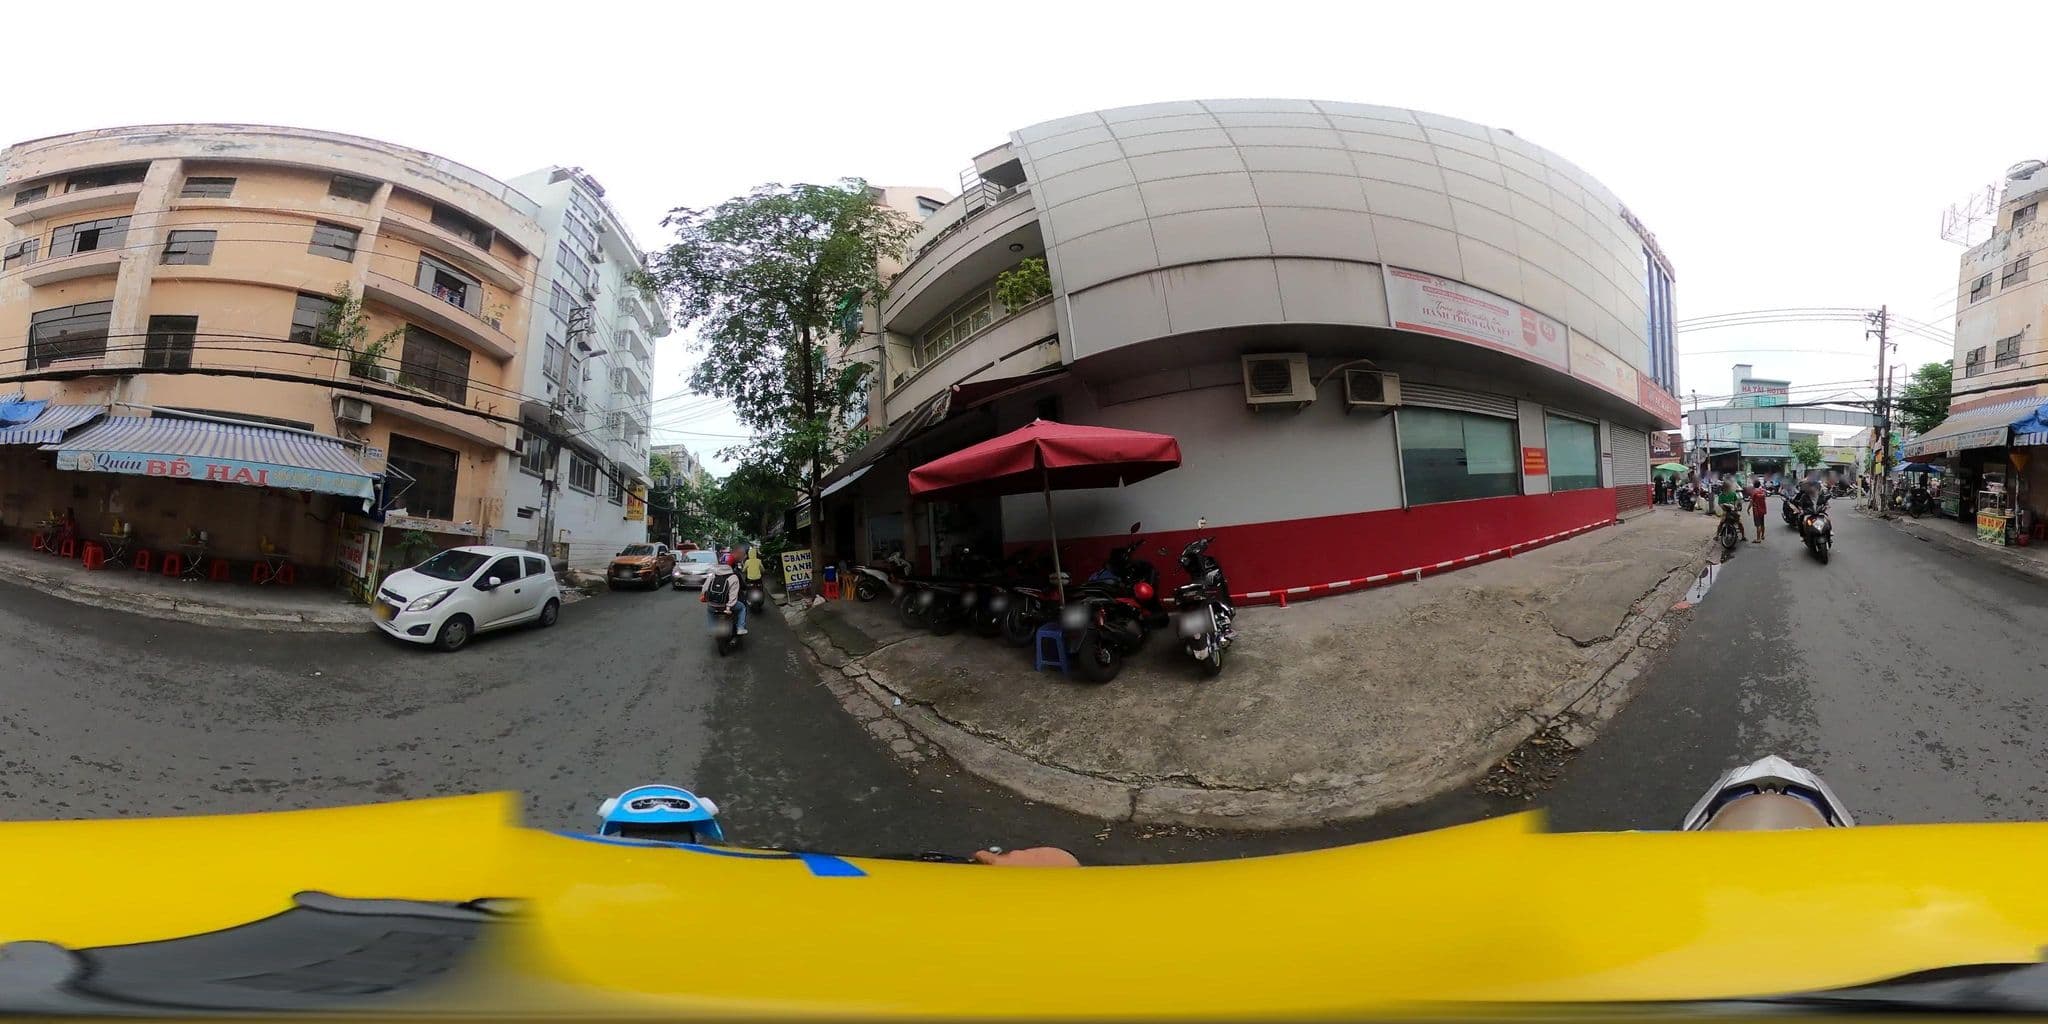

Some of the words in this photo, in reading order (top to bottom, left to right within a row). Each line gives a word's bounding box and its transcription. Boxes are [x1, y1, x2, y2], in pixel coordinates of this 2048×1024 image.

[97, 453, 142, 471] Quán
[205, 464, 270, 486] HAI
[785, 562, 812, 573] CANH
[791, 572, 810, 581] CUA
